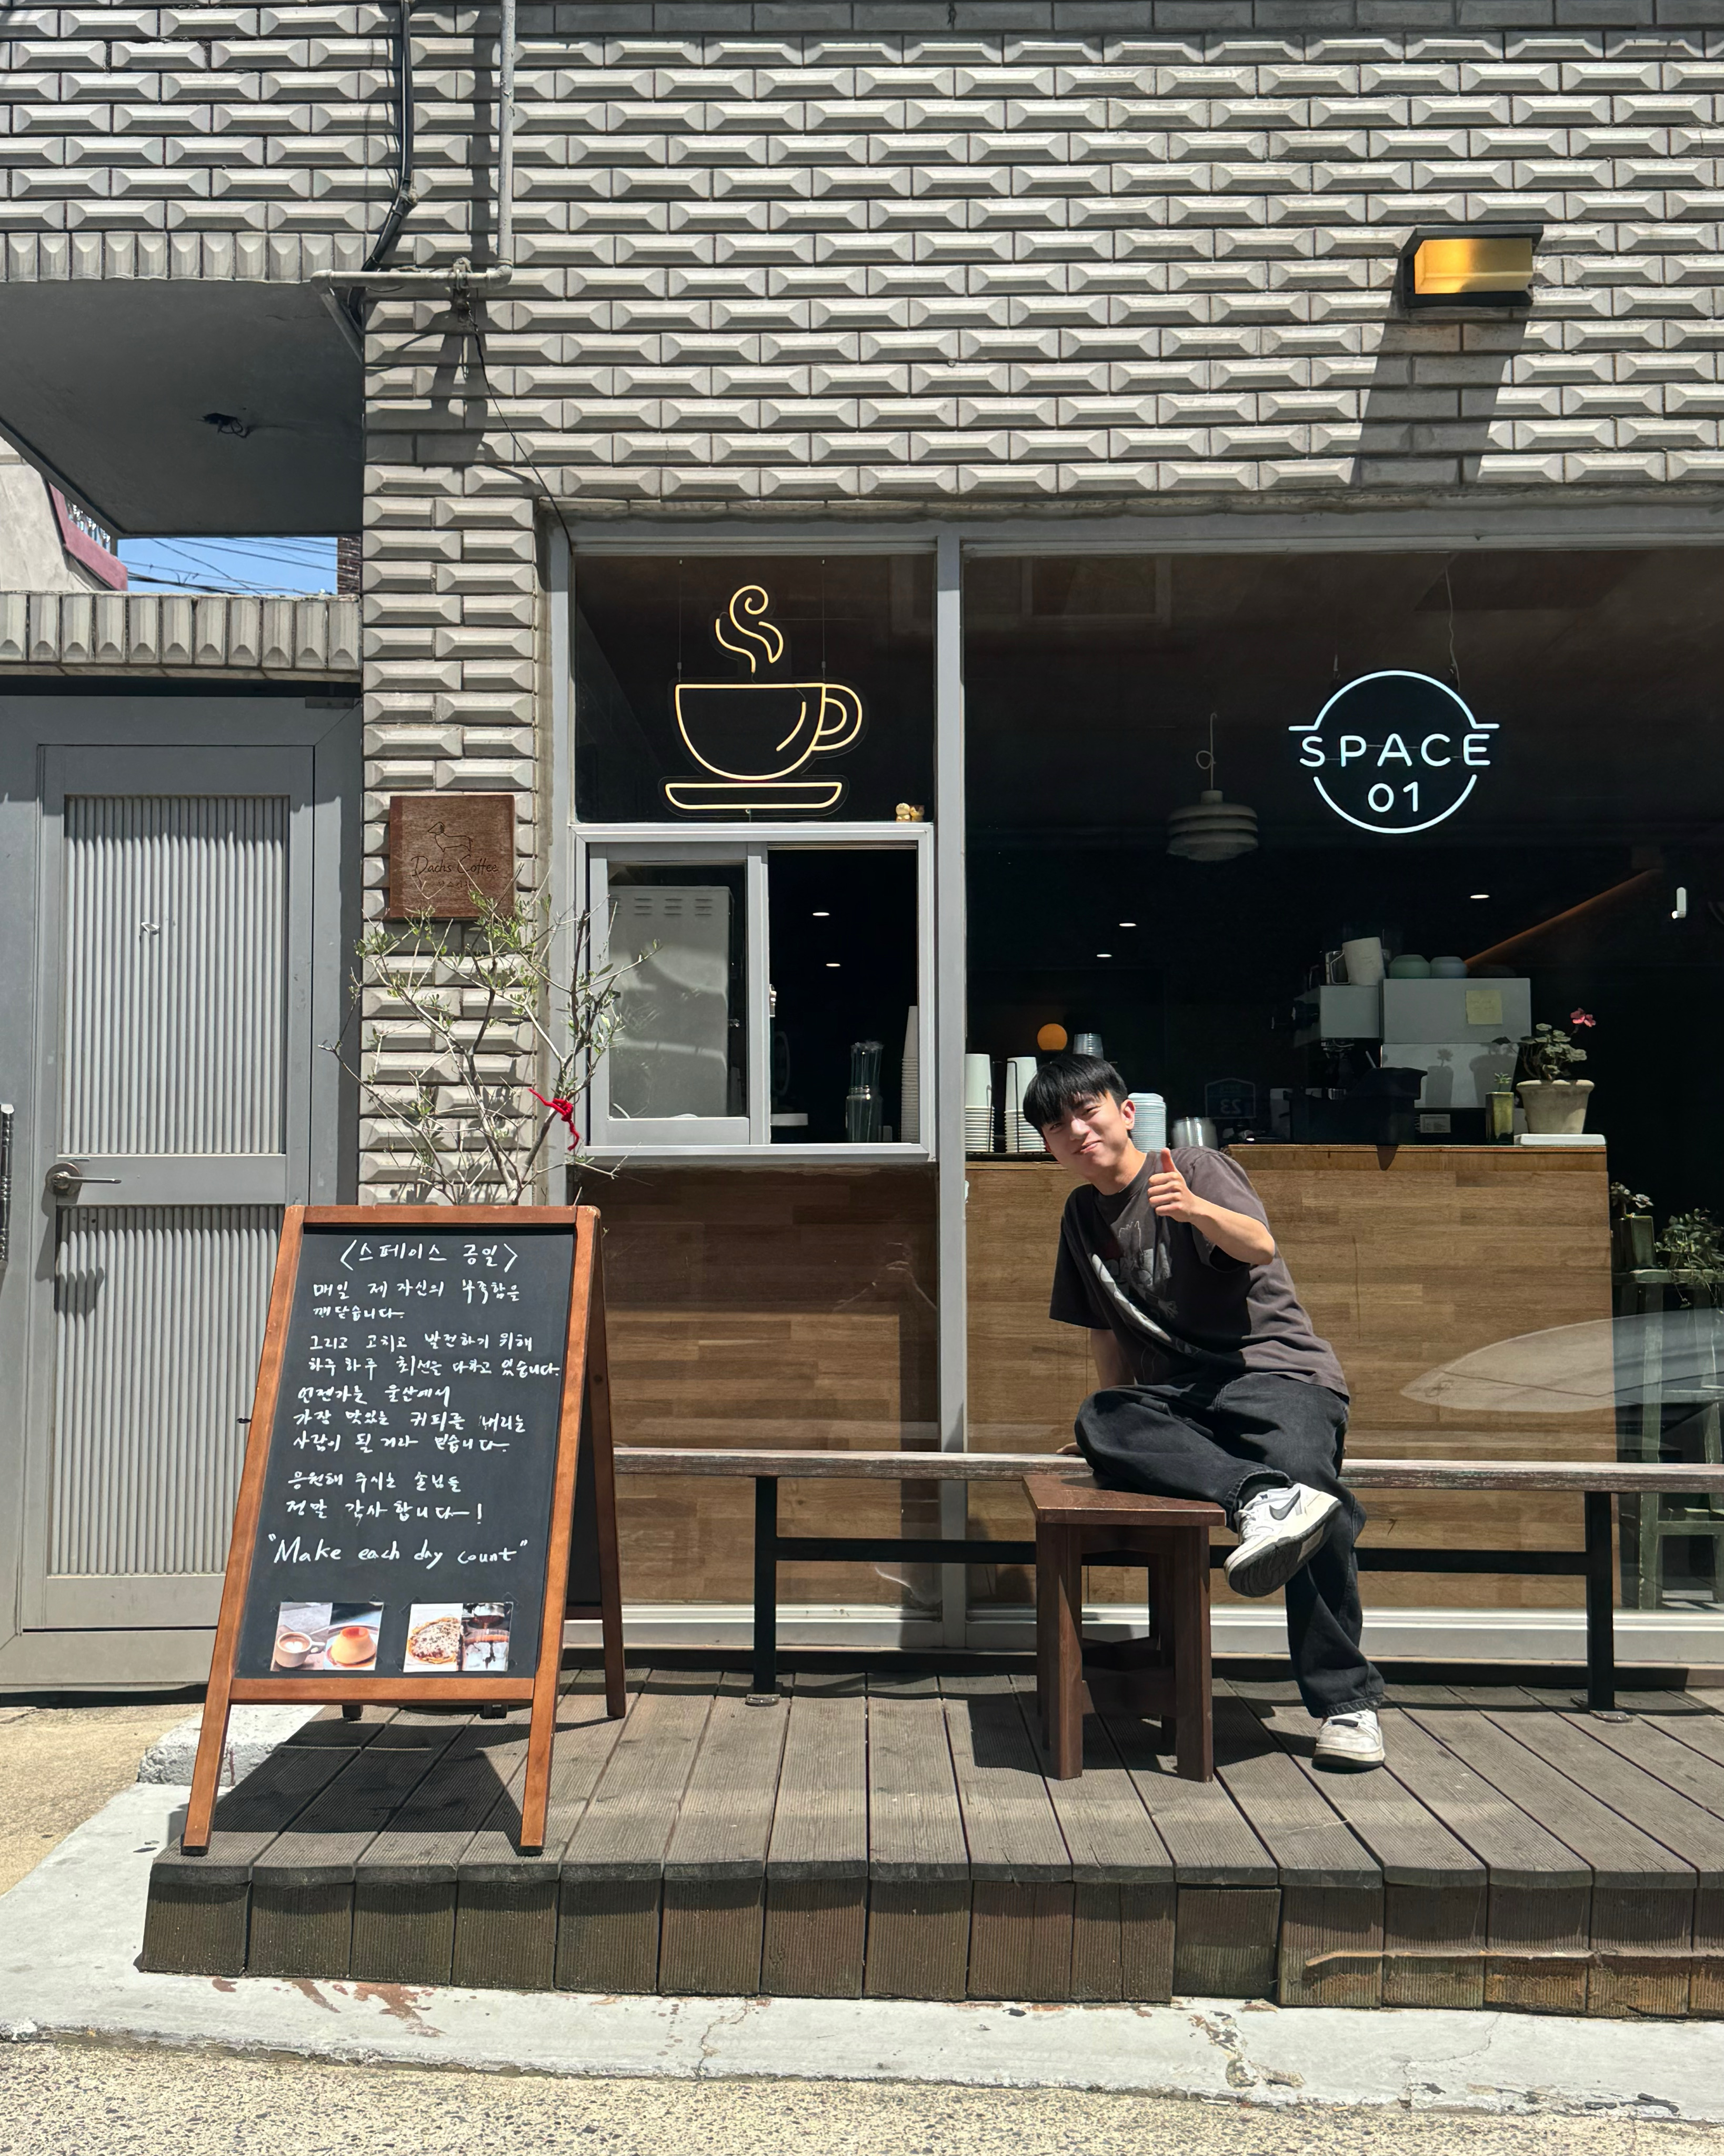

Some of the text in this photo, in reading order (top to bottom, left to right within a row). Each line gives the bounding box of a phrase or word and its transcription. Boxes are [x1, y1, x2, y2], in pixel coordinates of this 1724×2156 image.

[1299, 733, 1491, 767] SPACE
[410, 854, 498, 877] Dachs Coffee
[313, 1279, 519, 1304] 매일 제 자신의 부족함을
[309, 1330, 532, 1353] 그리고 고치고 발전하기 위해
[308, 1357, 336, 1376] 하루
[345, 1357, 378, 1381] 하루
[396, 1355, 442, 1376] 최선을
[452, 1359, 492, 1374] 다하고
[297, 1384, 450, 1408] 언젠가는 울산에서
[293, 1409, 332, 1425] 가장
[345, 1409, 389, 1425] 맛있는
[479, 1412, 526, 1433] 내리는
[293, 1430, 341, 1452] 사람이
[355, 1433, 373, 1453] 될
[380, 1434, 419, 1448] 거라
[287, 1471, 343, 1490] 응원해
[355, 1471, 396, 1493] 주시는
[286, 1499, 327, 1519] 정말
[358, 1540, 400, 1560] each
